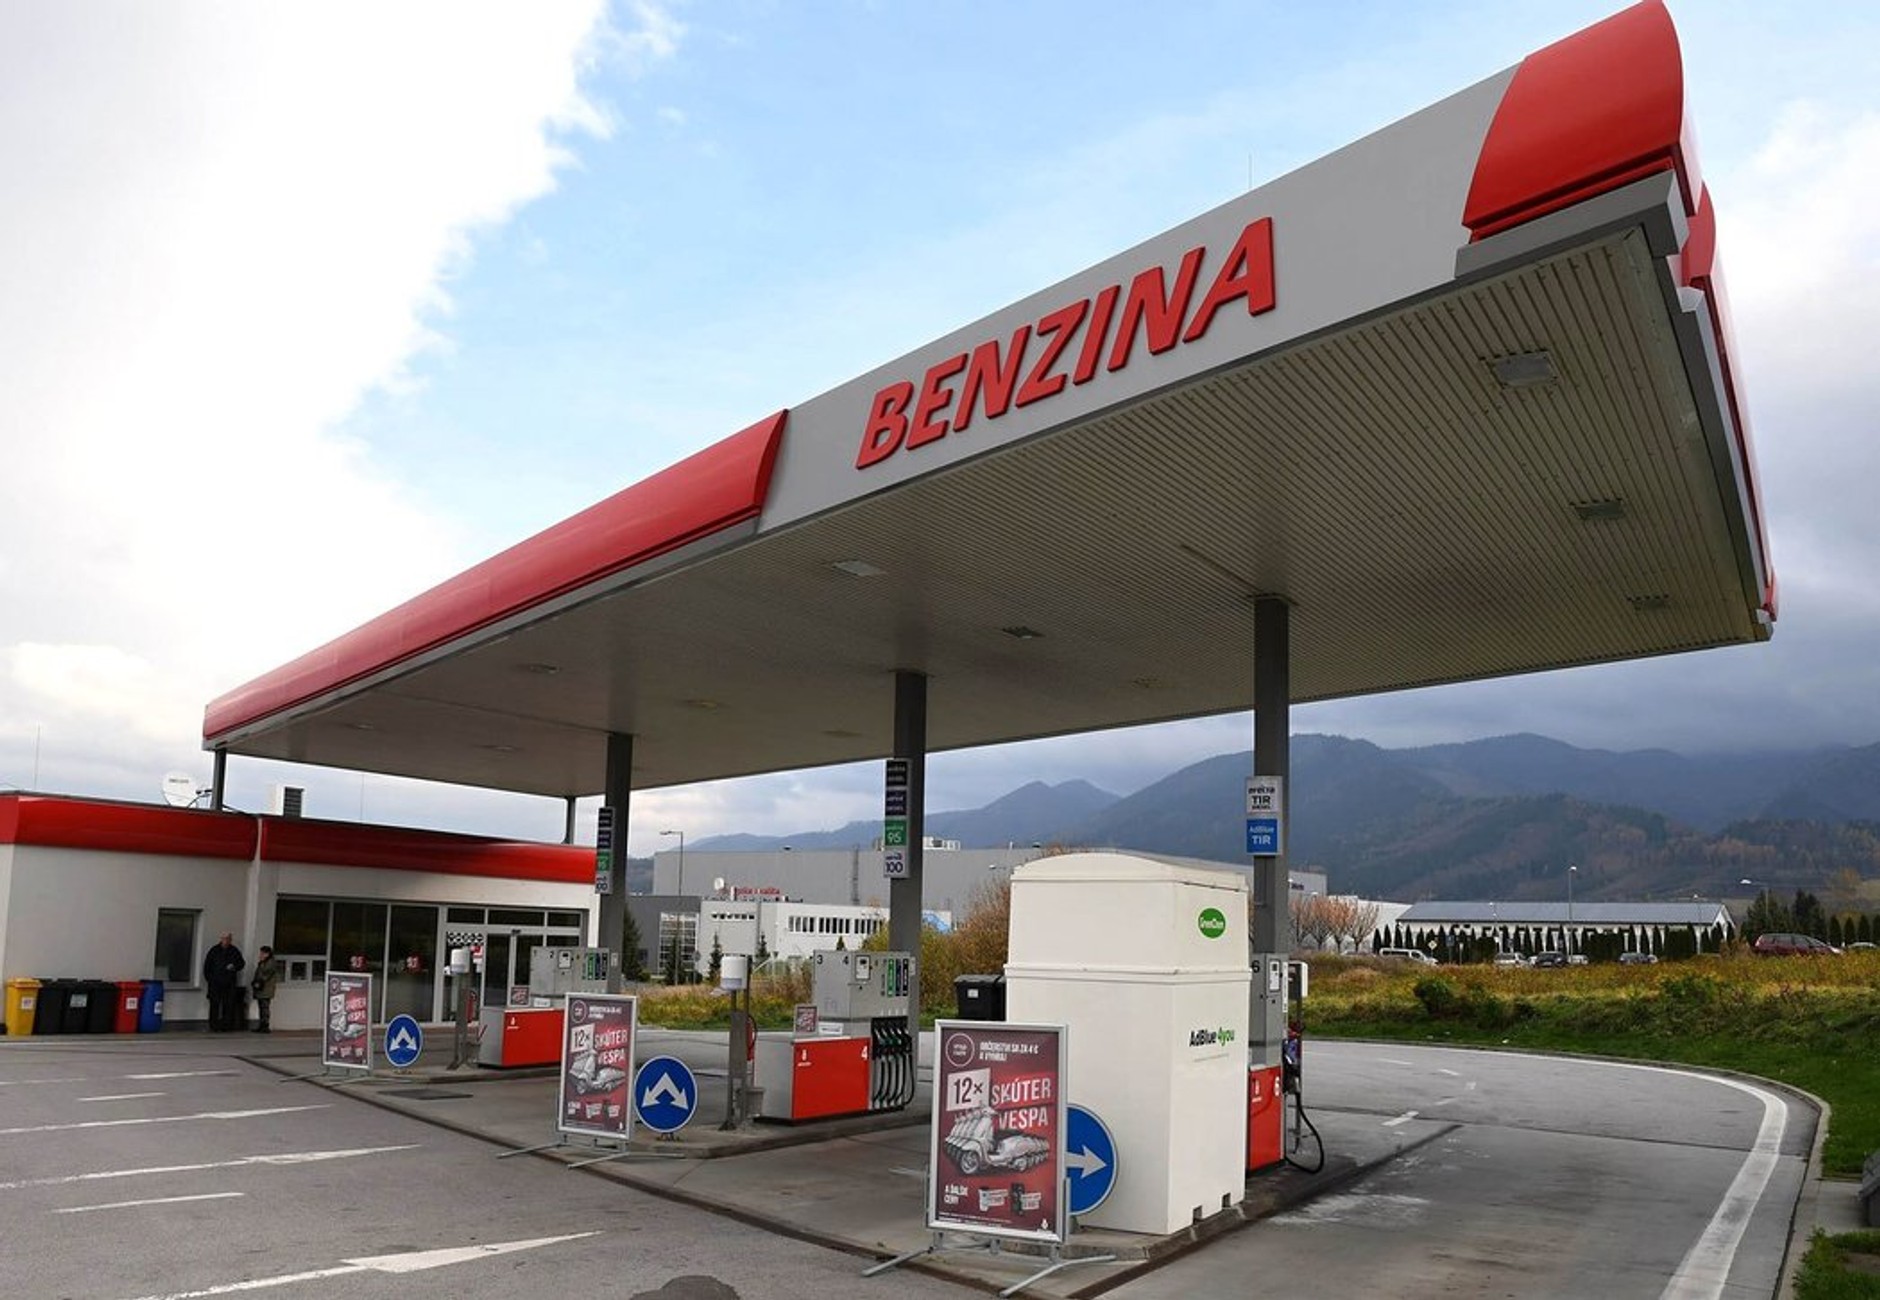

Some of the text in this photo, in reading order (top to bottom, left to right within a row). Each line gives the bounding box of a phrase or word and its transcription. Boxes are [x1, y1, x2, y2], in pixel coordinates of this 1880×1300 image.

[856, 217, 1276, 470] BENZINA
[1252, 795, 1271, 805] TIR
[1252, 835, 1271, 845] TIR
[886, 861, 903, 873] 100
[816, 954, 849, 965] 3 4
[1252, 960, 1260, 973] 6
[861, 1045, 868, 1060] 4
[991, 1077, 1051, 1106] SKÚTER
[1000, 1106, 1048, 1130] VESPA
